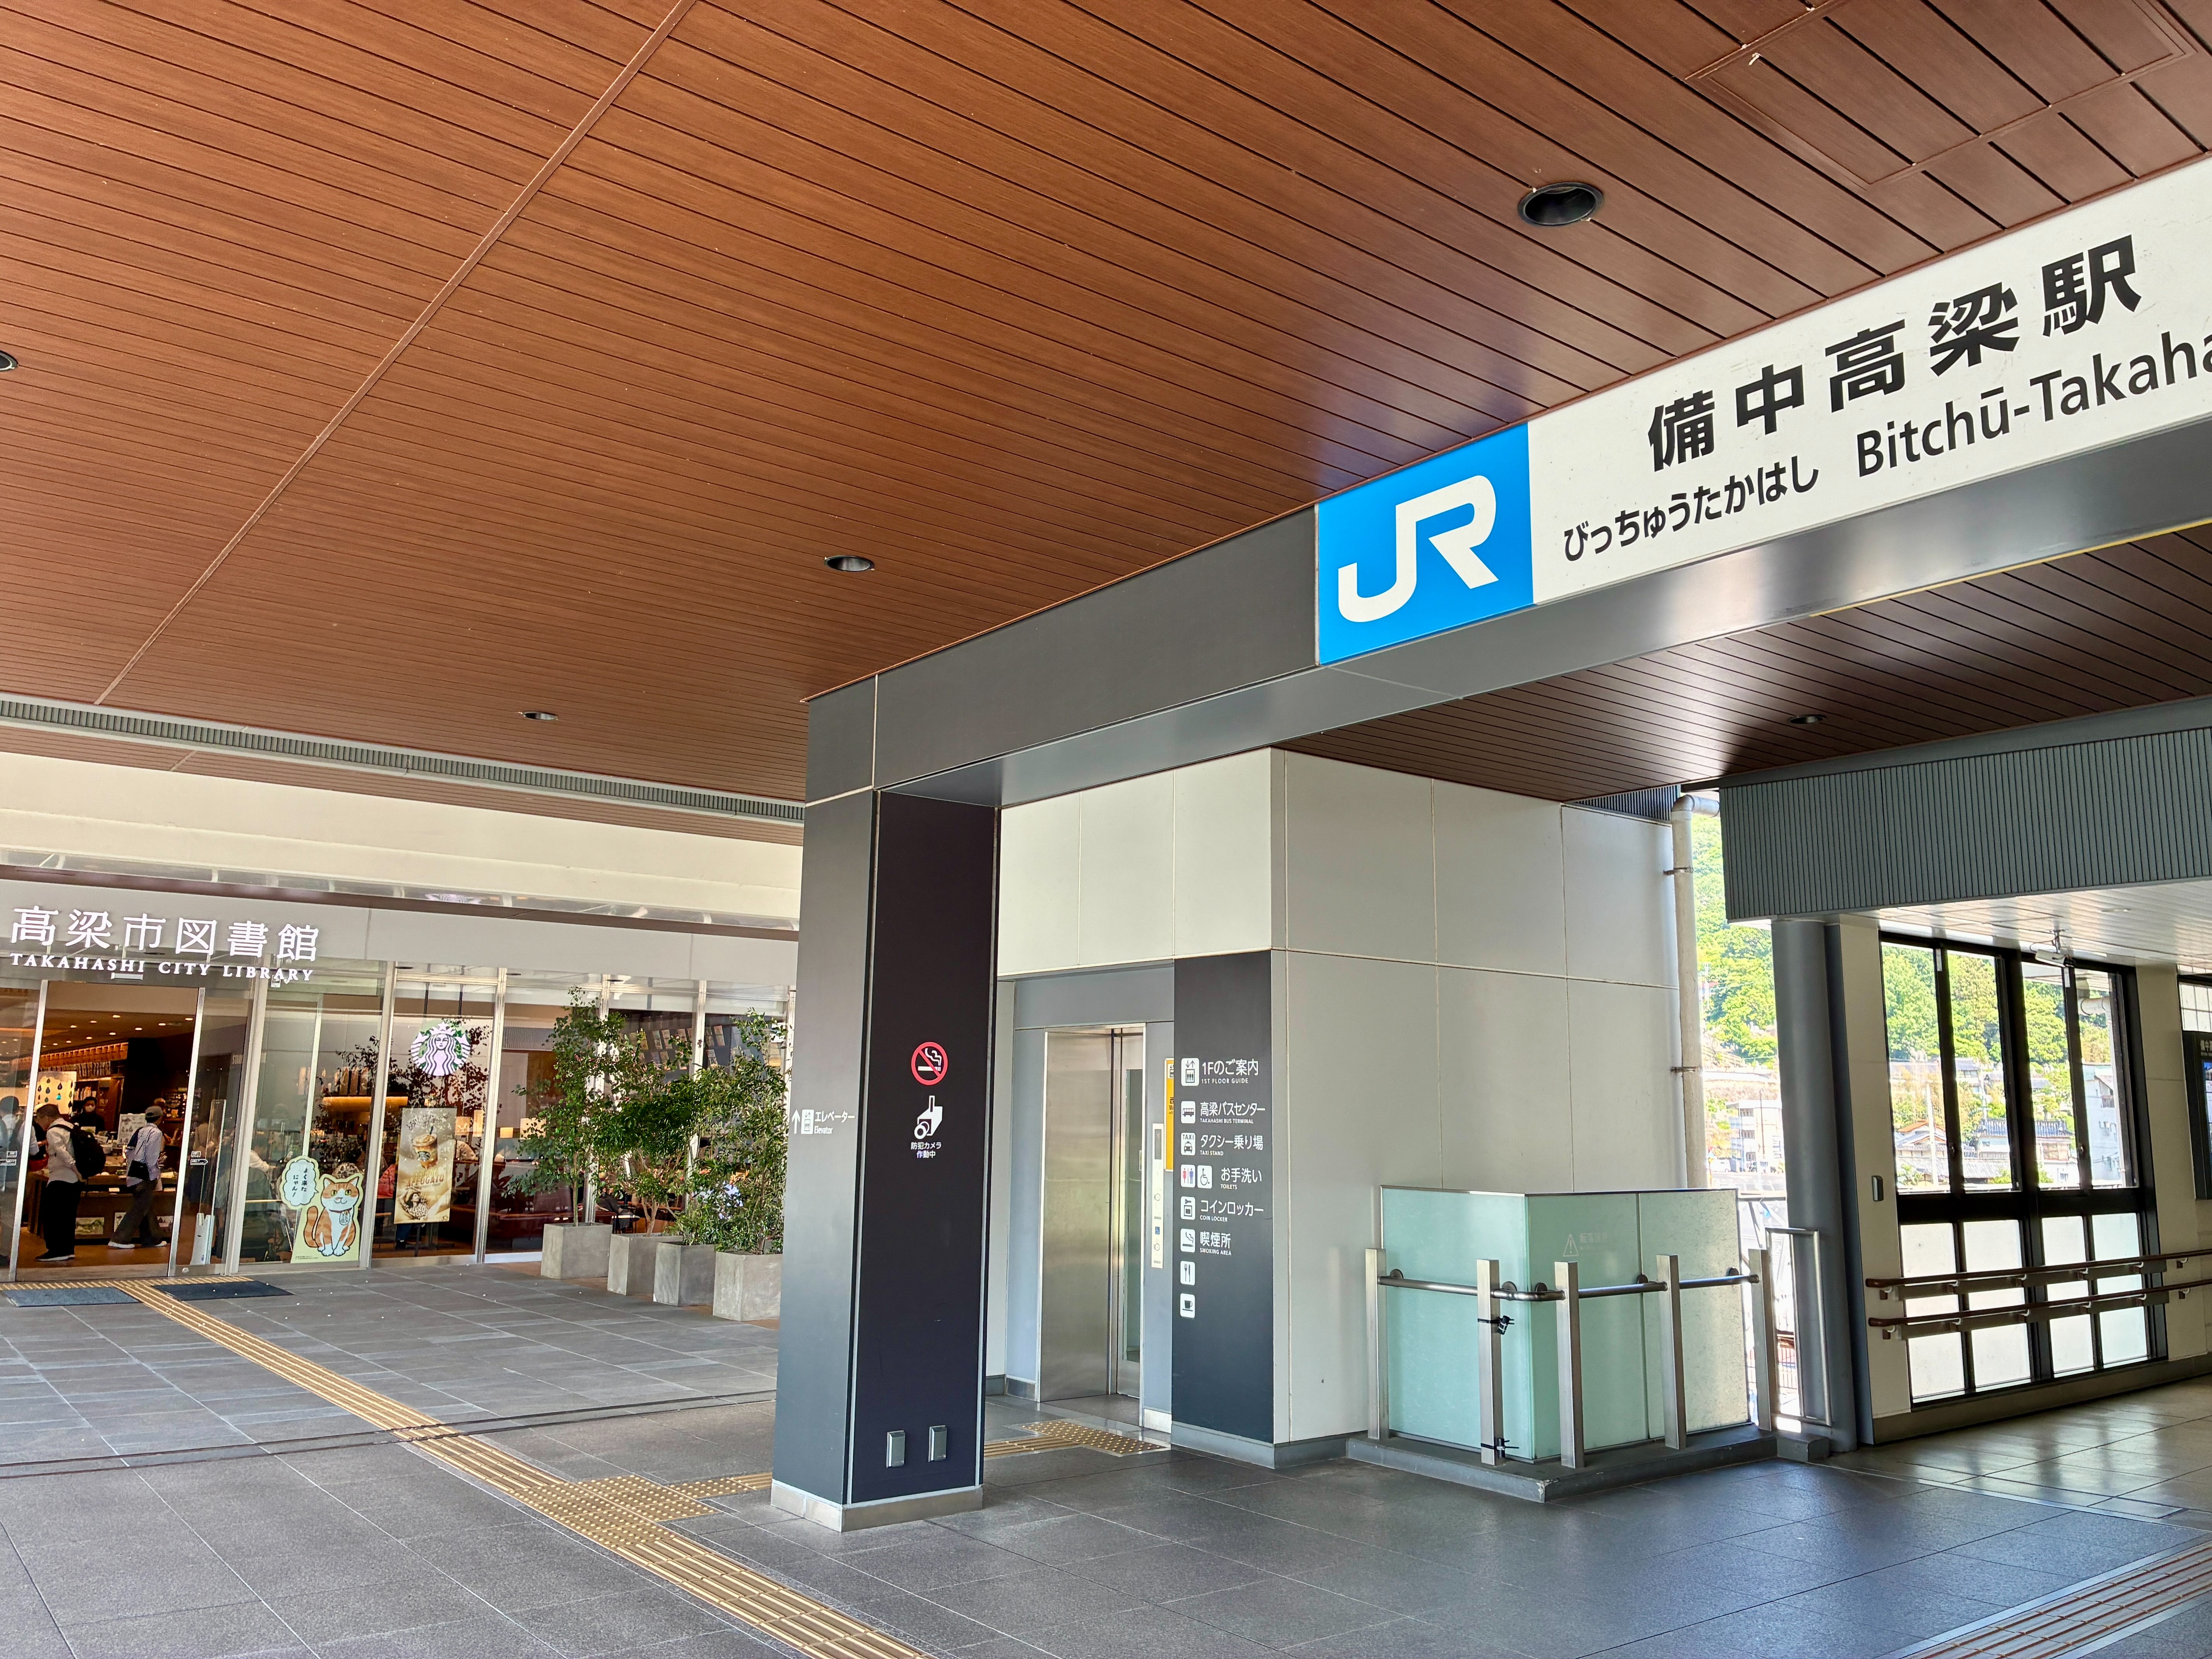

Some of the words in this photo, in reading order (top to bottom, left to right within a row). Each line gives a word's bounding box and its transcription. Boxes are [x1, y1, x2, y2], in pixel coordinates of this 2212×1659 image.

[1648, 234, 2142, 472] 備中高梁駅
[1564, 455, 1819, 561] びっちゅうたかはし
[1338, 475, 1499, 623] JR
[10, 905, 319, 962] 高梁市図書館
[10, 953, 145, 973] TAKAHASHI
[158, 962, 211, 976] CITY
[223, 965, 313, 981] LIBRARY
[1202, 1058, 1259, 1076] 1Fのご案内
[814, 1111, 855, 1123] エレベーター
[1200, 1101, 1266, 1116] 高梁バスセンター
[814, 1125, 833, 1134] Elevator
[910, 1142, 942, 1150] 防犯カメラ
[1200, 1135, 1263, 1151] タクシー乗り場
[916, 1150, 936, 1159] 作動中
[1221, 1167, 1262, 1183] お手洗い
[1200, 1200, 1264, 1217] コインロッカー
[1200, 1231, 1231, 1249] 喫煙所
